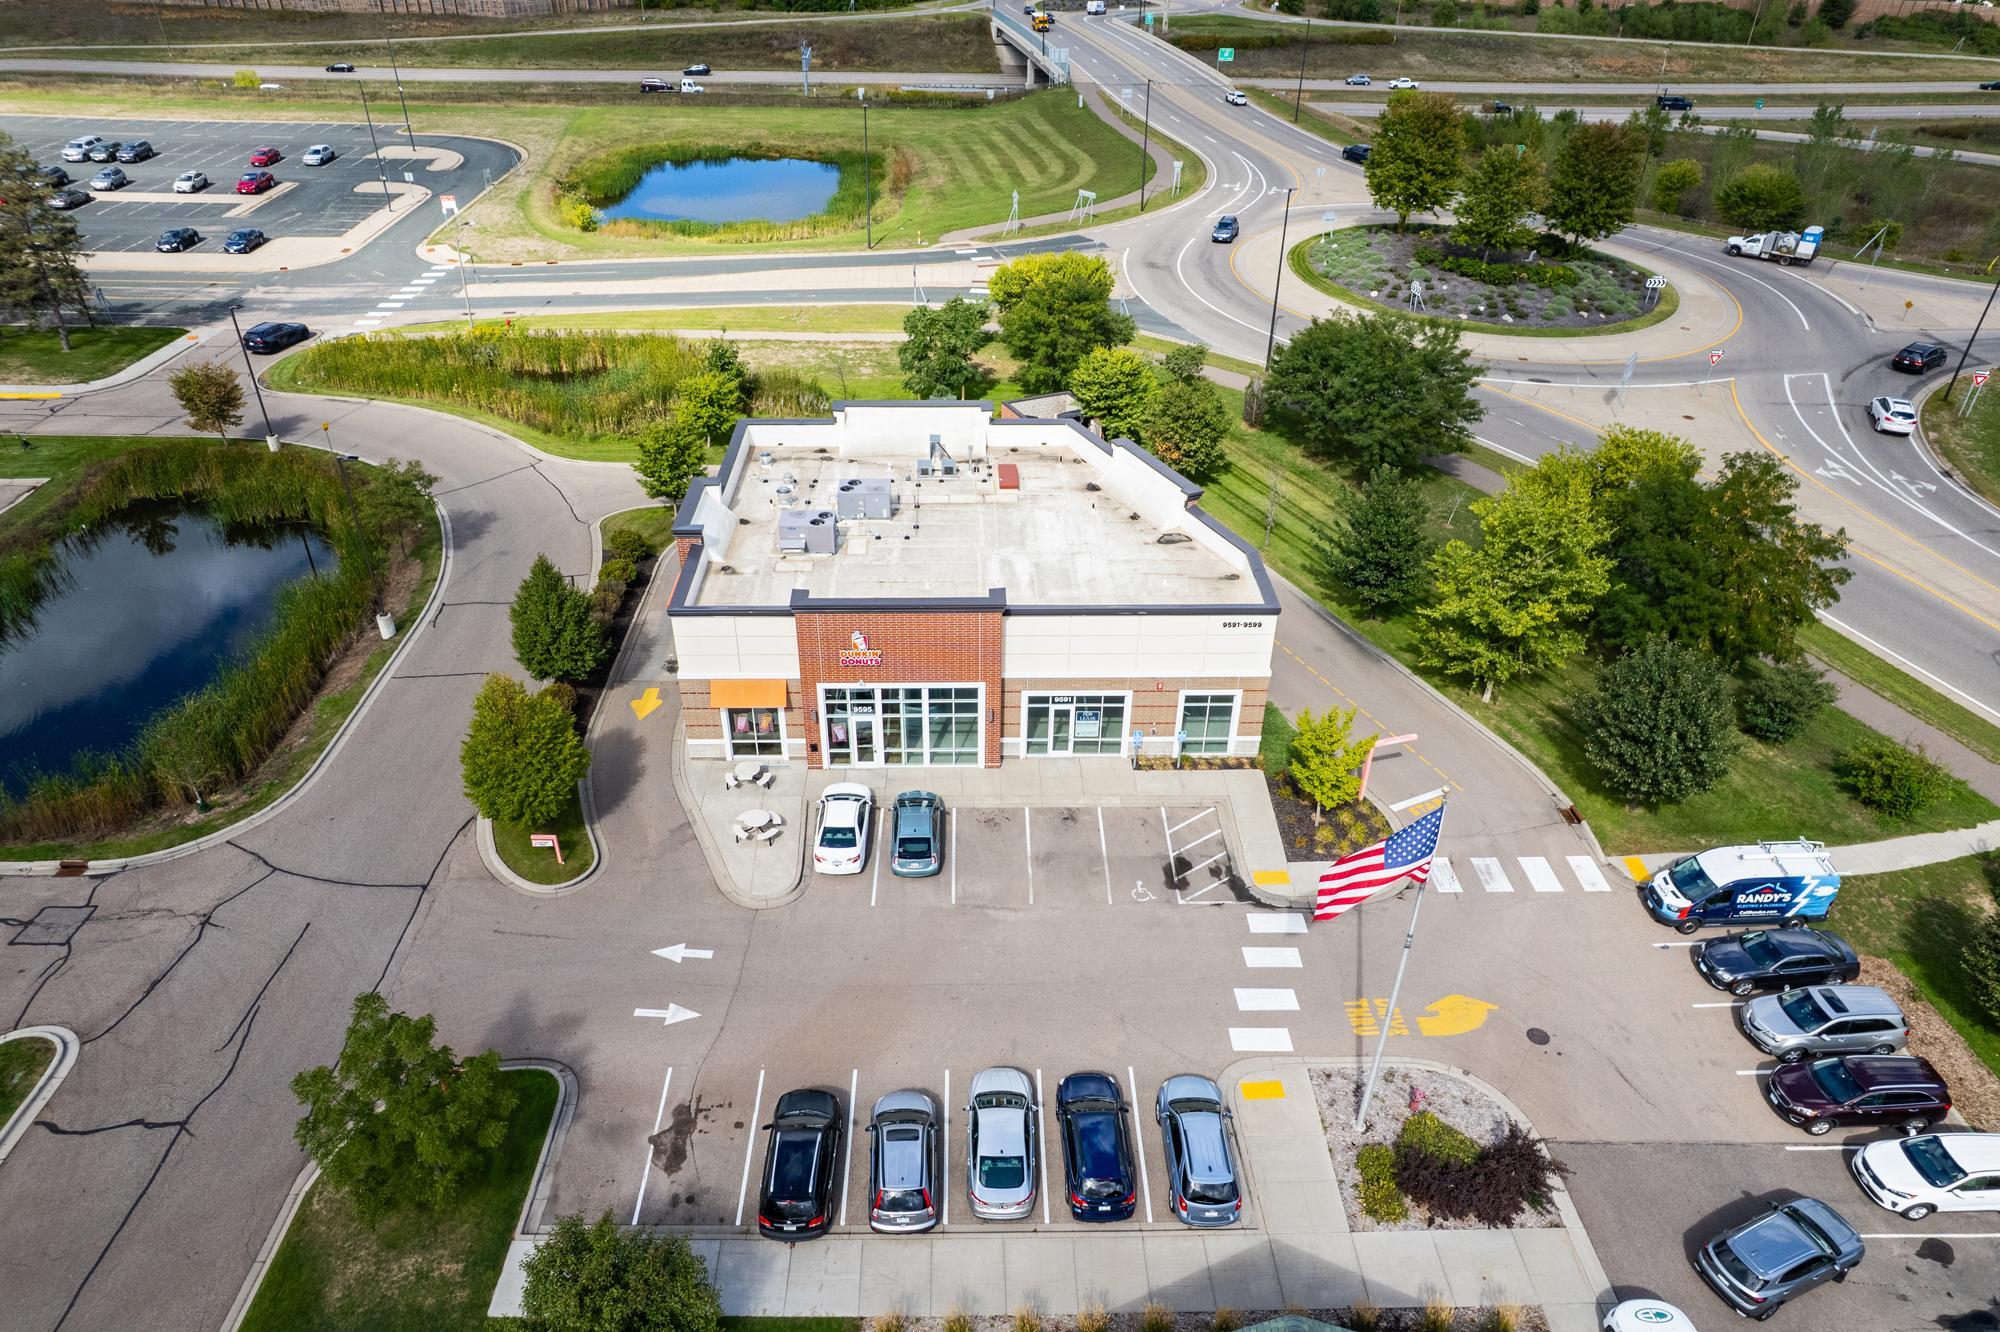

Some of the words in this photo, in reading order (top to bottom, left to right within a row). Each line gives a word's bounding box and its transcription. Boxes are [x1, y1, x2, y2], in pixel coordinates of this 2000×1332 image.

[841, 657, 881, 665] DONUTS
[1736, 893, 1792, 903] RANDY'S
[1343, 998, 1380, 1036] THRU
